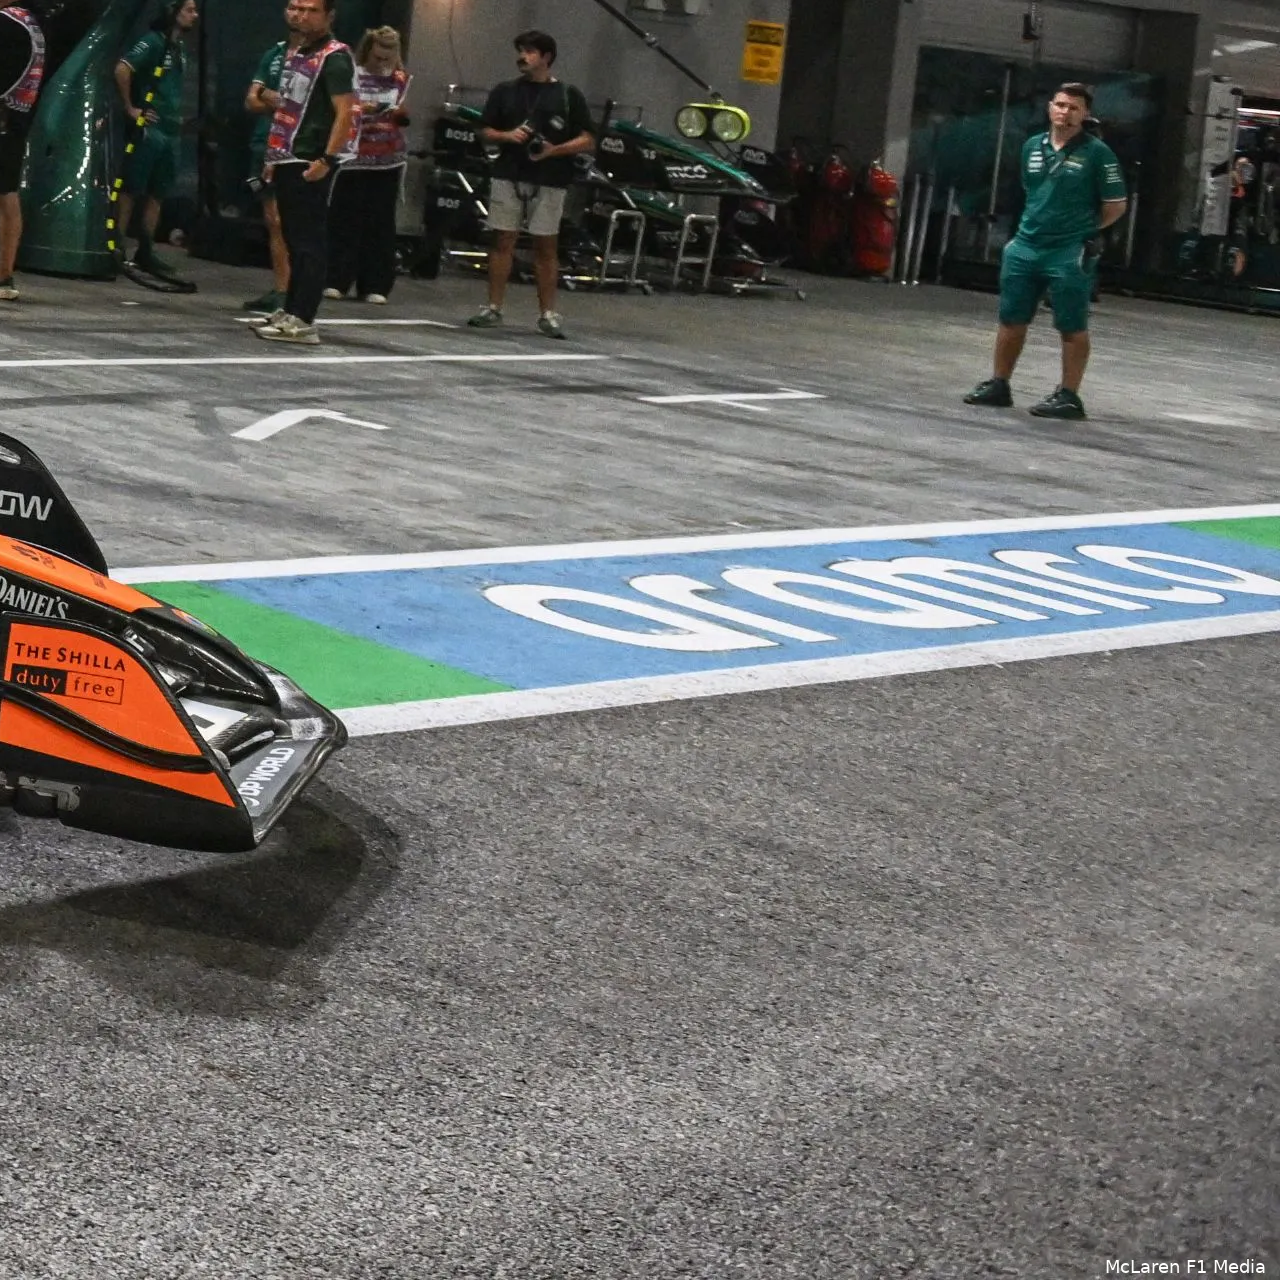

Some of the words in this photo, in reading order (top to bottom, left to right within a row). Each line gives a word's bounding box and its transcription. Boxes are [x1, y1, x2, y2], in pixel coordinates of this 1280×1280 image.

[445, 127, 475, 144] BOSS
[482, 544, 1280, 652] aramco
[14, 642, 52, 660] THE
[57, 647, 127, 672] SHILLA
[16, 669, 62, 692] duty
[73, 676, 116, 698] free
[245, 747, 296, 781] WORLD
